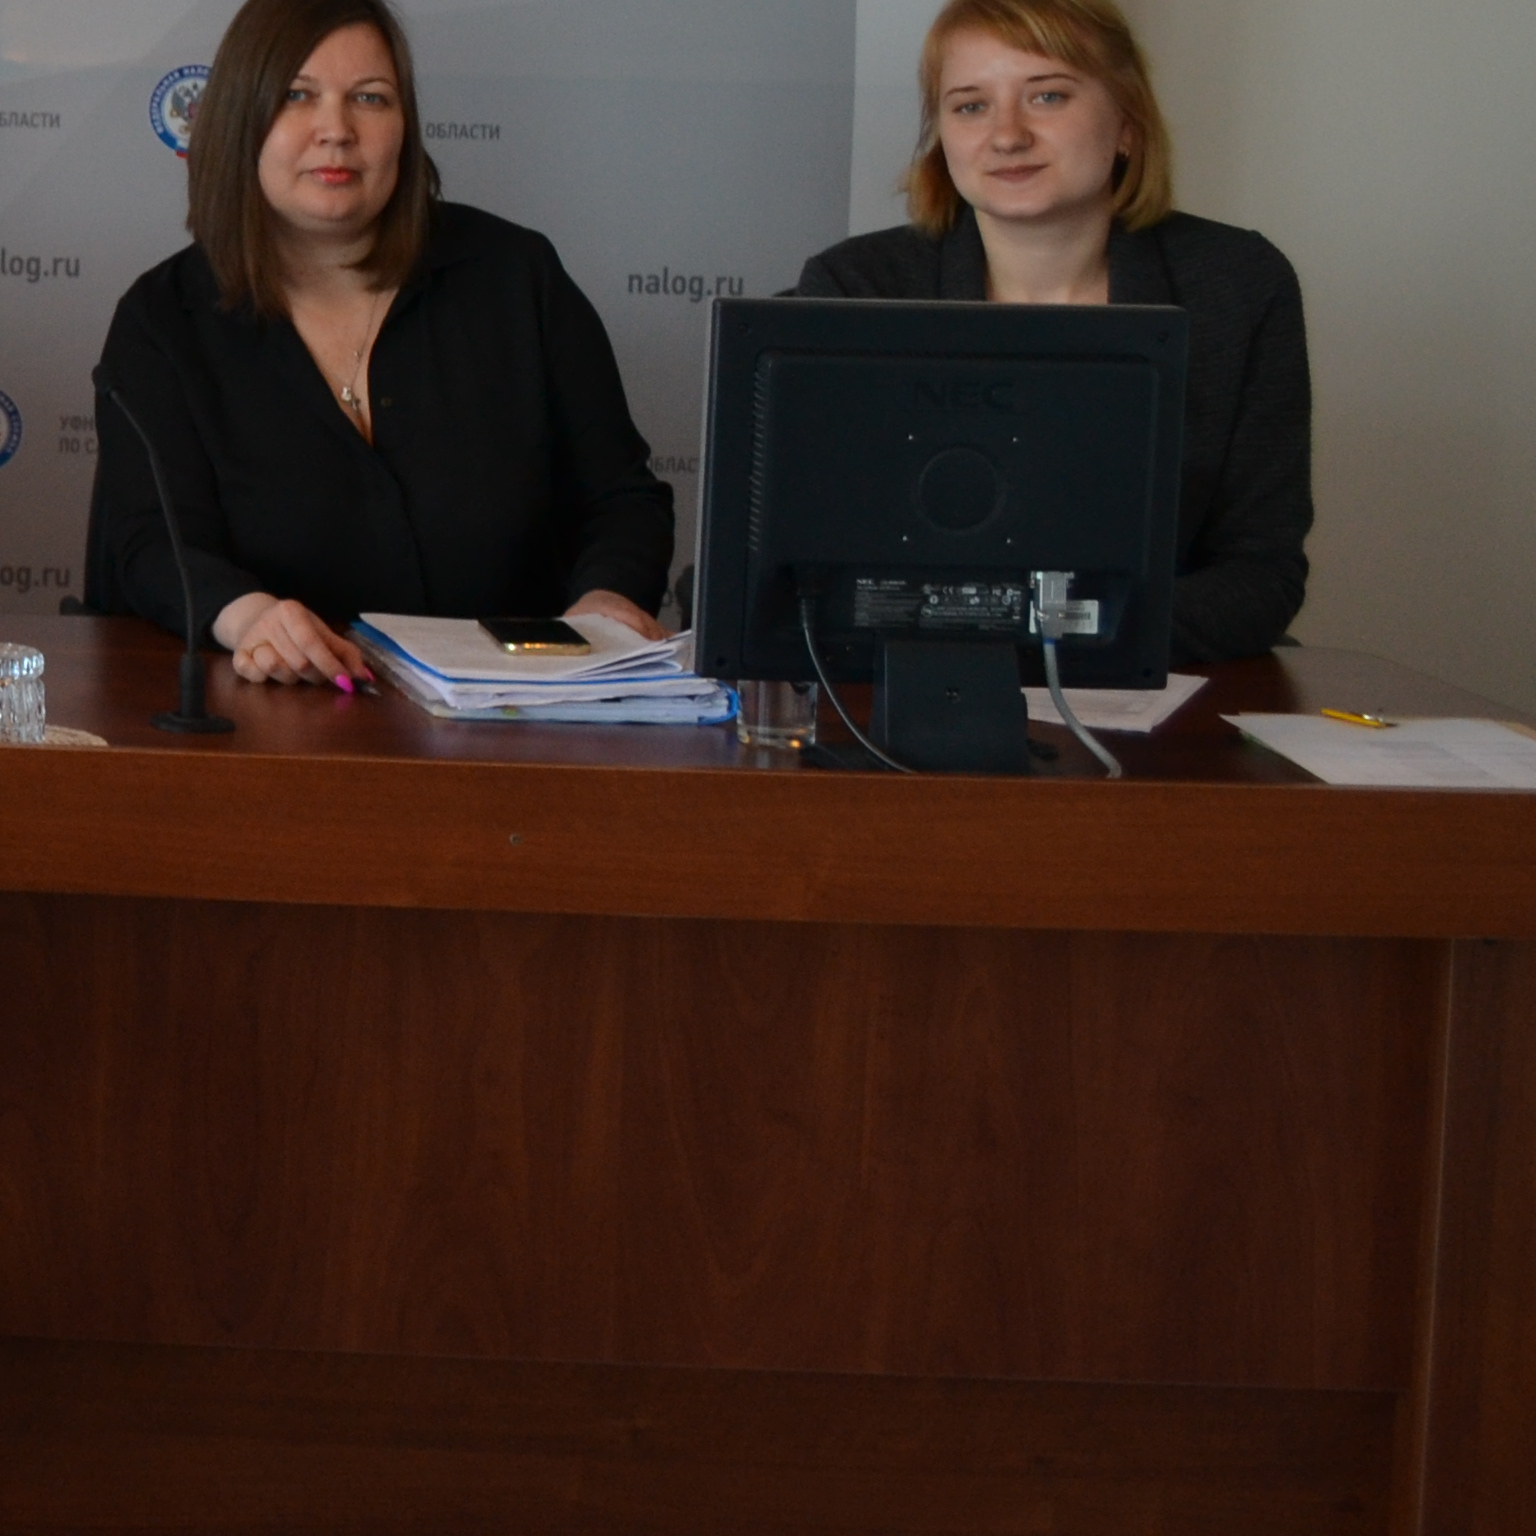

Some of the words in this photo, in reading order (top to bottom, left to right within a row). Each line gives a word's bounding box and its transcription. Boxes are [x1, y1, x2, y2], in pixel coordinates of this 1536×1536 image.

[422, 123, 501, 145] ОБЛАСТИ
[628, 267, 747, 306] nalog.ru
[912, 381, 1015, 409] NEC
[59, 438, 80, 453] ПО
